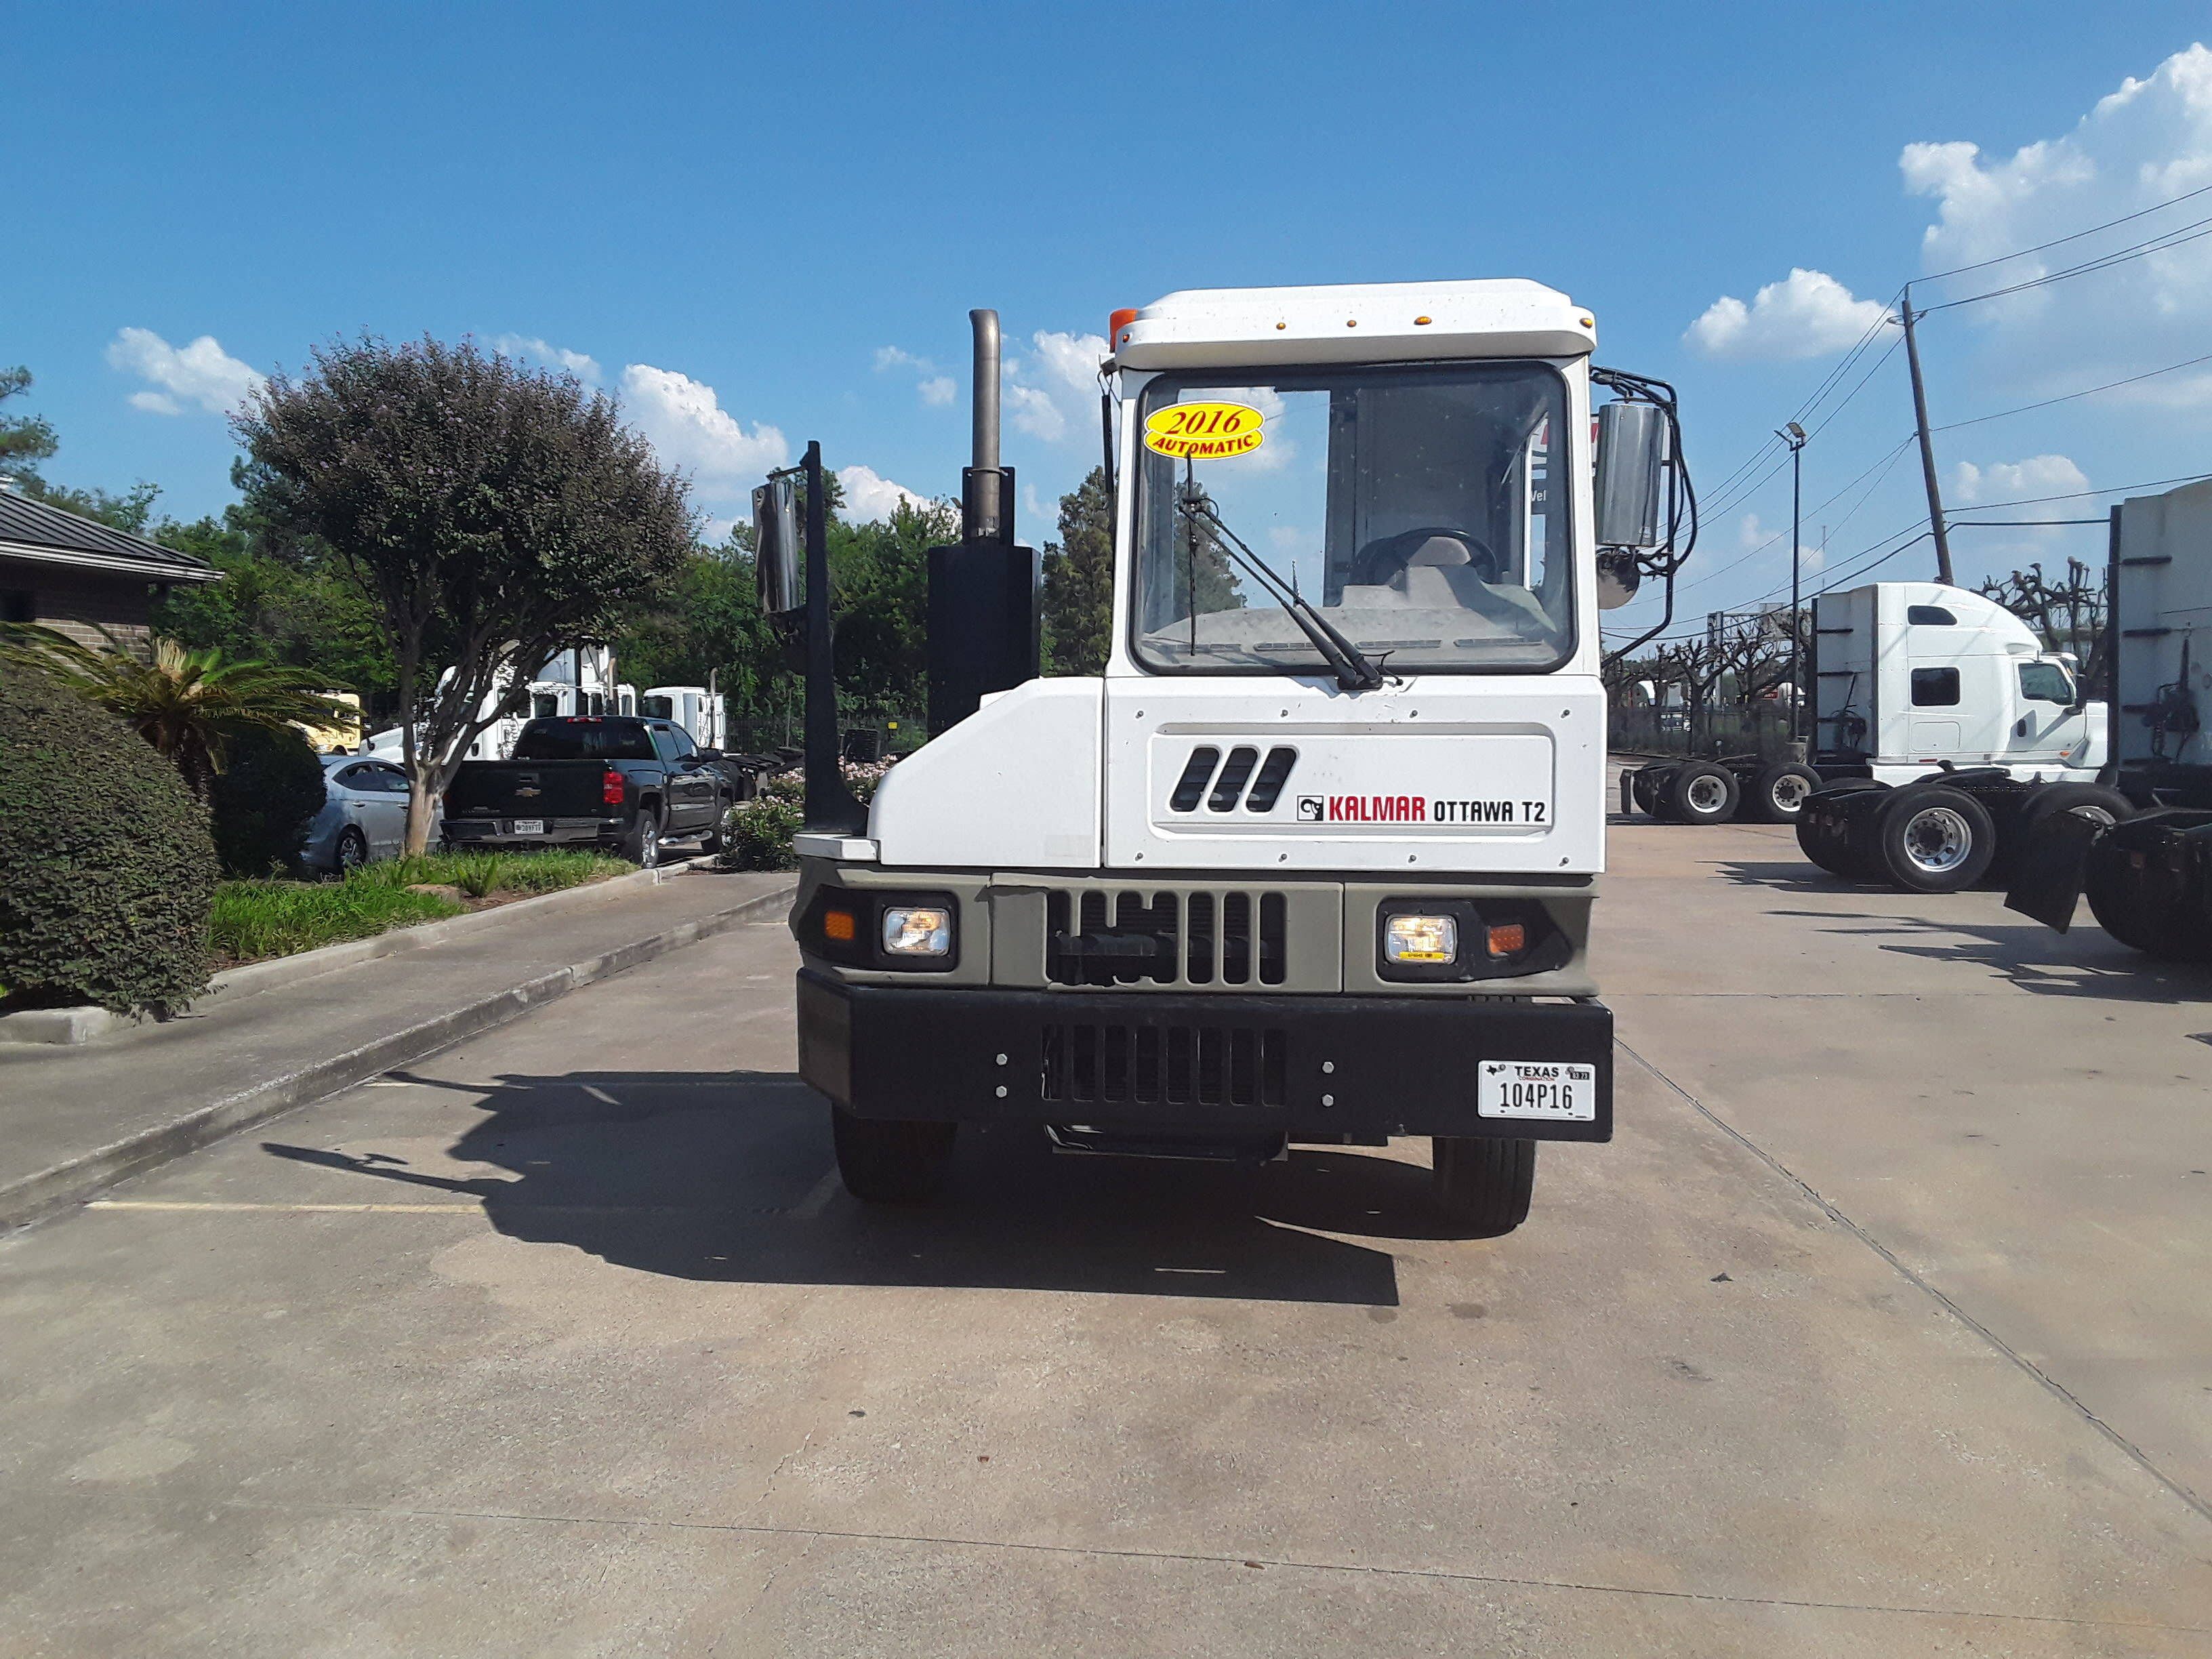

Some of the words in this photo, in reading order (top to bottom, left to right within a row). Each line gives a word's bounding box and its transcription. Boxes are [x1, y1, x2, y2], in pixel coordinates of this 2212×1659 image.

[1165, 409, 1246, 434] 2016
[1153, 434, 1254, 455] AUTOMATIC
[1329, 796, 1426, 821] KALMAR
[1434, 801, 1513, 822] OTTAWA
[1521, 802, 1545, 822] T2
[1515, 1066, 1559, 1078] TEXAS
[1500, 1082, 1573, 1109] 104P16
